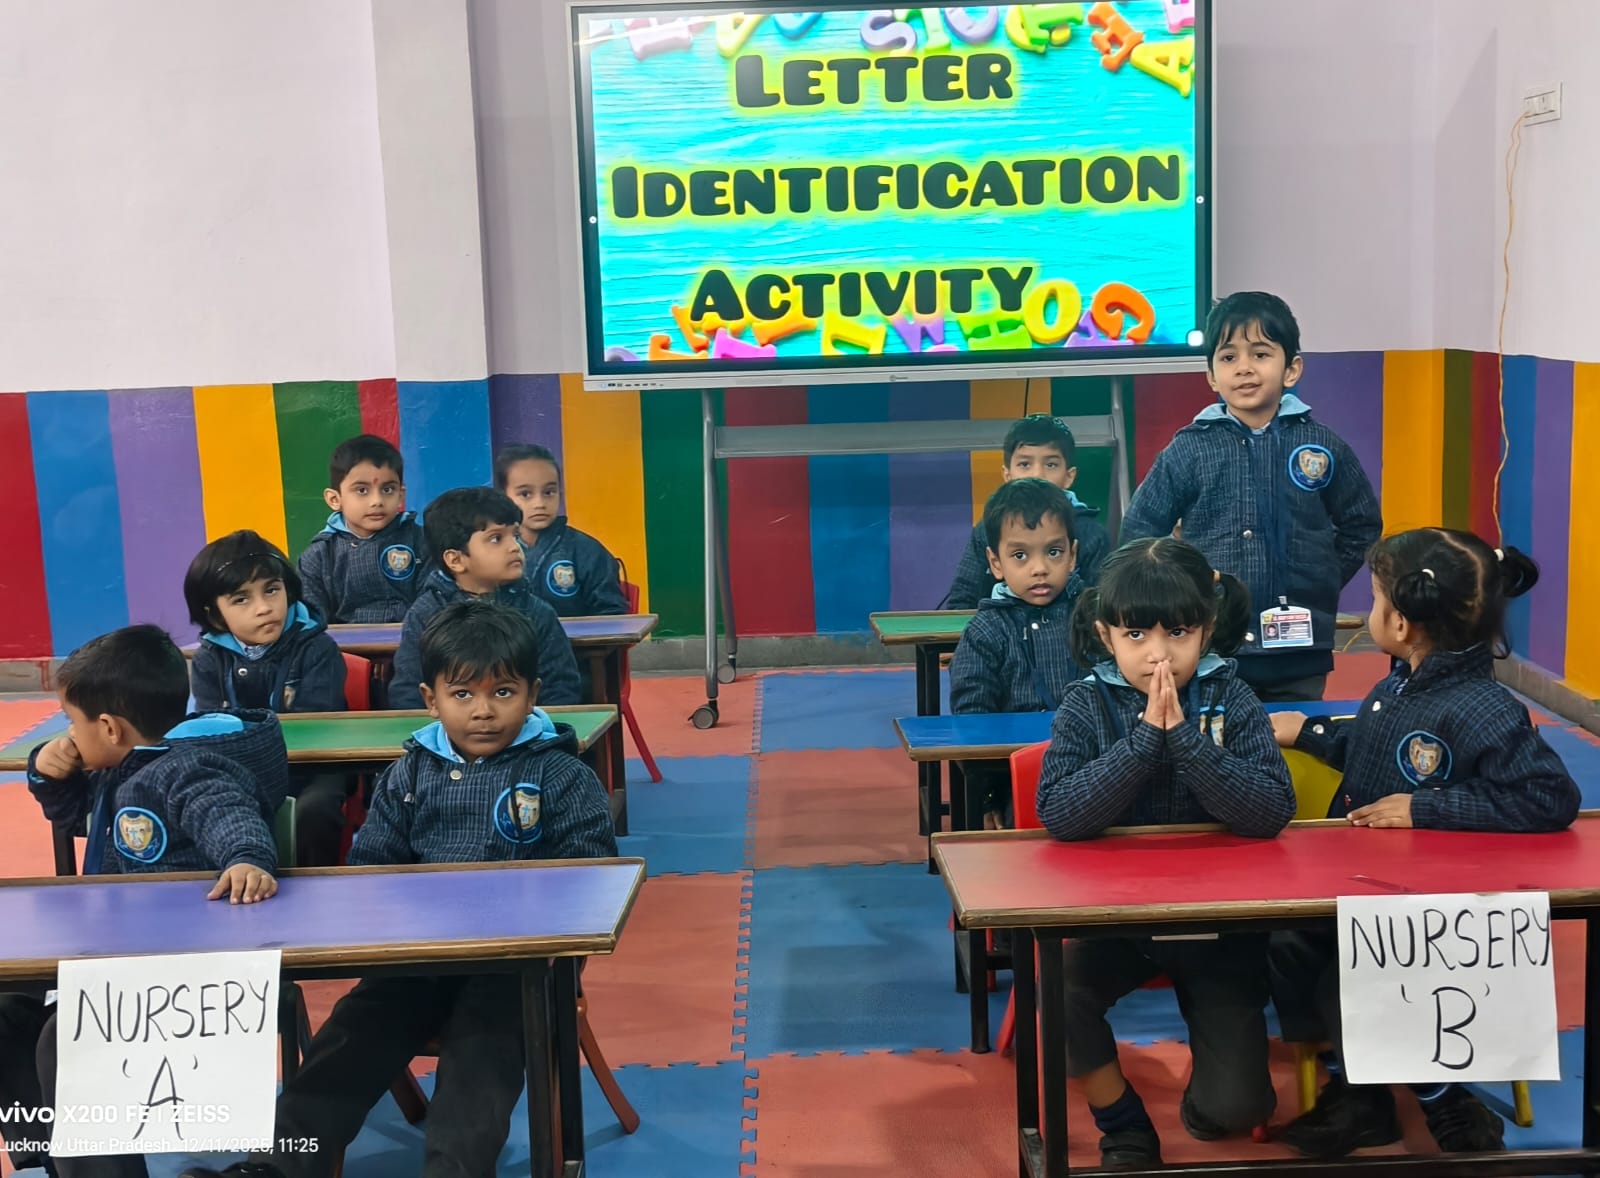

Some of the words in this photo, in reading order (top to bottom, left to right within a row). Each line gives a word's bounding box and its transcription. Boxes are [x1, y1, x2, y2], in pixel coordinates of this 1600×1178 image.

[736, 53, 1013, 108] LETTER
[611, 155, 1181, 219] IDENTIFICATION
[690, 266, 1034, 321] ACTIVITY
[1351, 907, 1550, 970] NURSERY
[73, 980, 269, 1042] NURSERY
